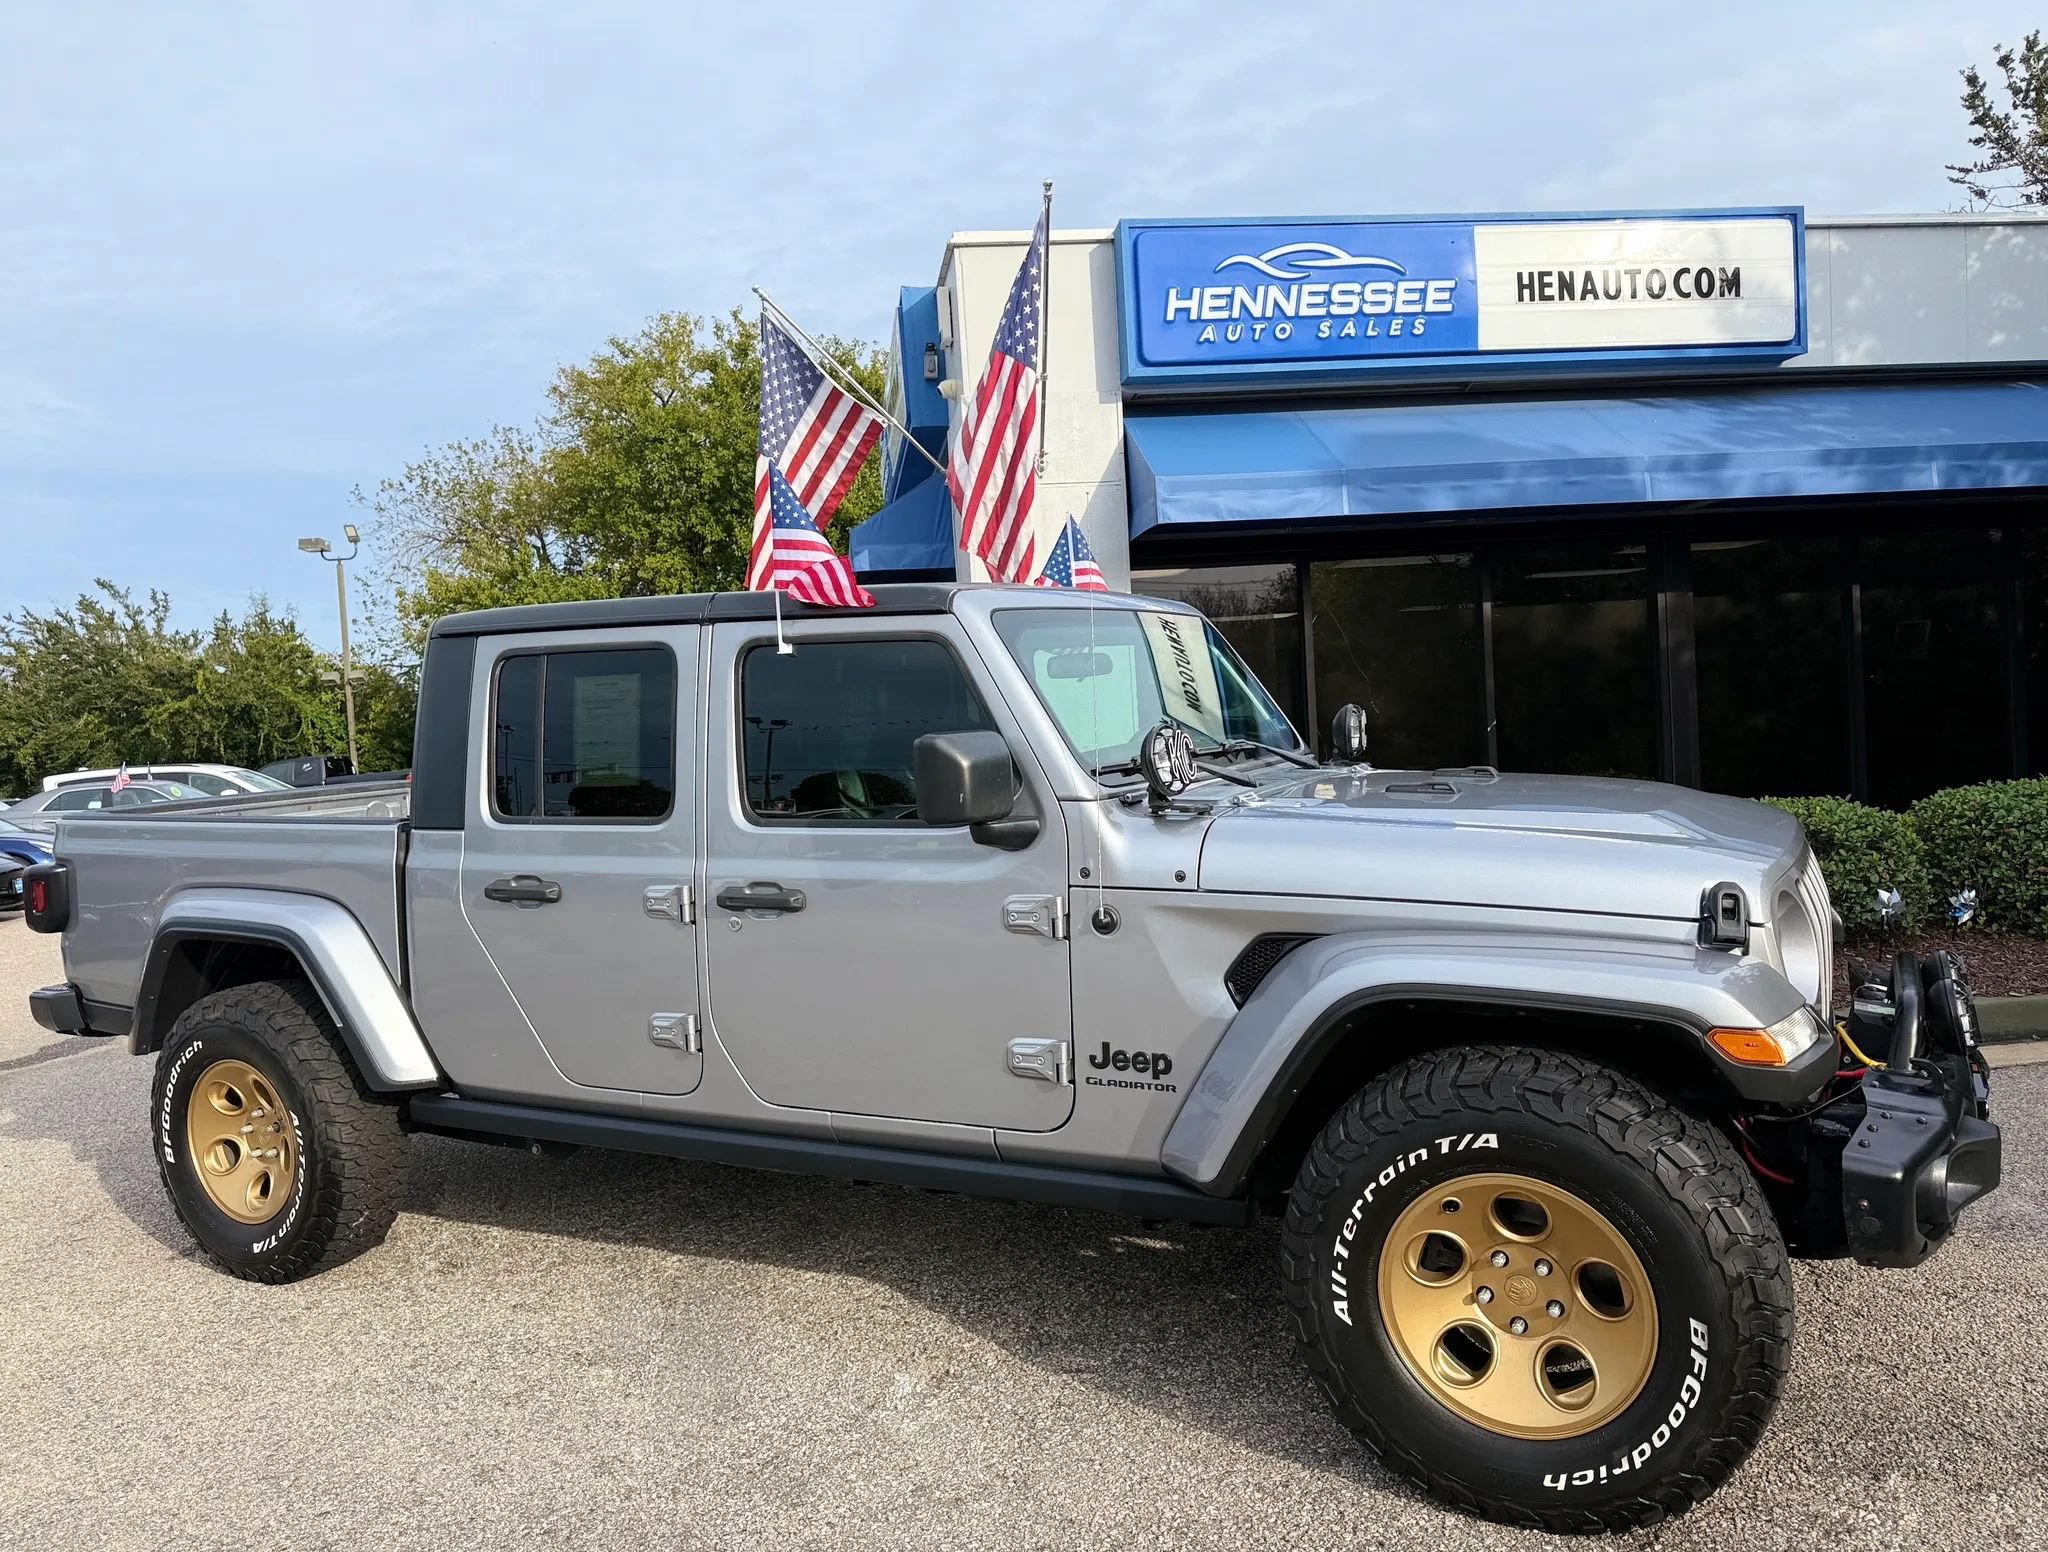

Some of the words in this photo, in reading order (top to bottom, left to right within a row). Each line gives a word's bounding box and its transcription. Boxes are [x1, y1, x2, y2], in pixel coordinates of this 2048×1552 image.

[1166, 279, 1457, 321] HENNESSEE
[1199, 322, 1293, 343] AUTO
[1317, 318, 1426, 338] SALES
[1089, 1041, 1173, 1080] Jeep
[161, 1040, 203, 1164] BFGoodrich
[1085, 1076, 1177, 1093] GLADIATOR
[279, 1110, 306, 1237] All-Terrain
[252, 1234, 278, 1254] T/A
[1331, 1148, 1428, 1327] All-Terrain
[1435, 1133, 1500, 1155] T/A
[1543, 1317, 1708, 1491] BFGoodrich
